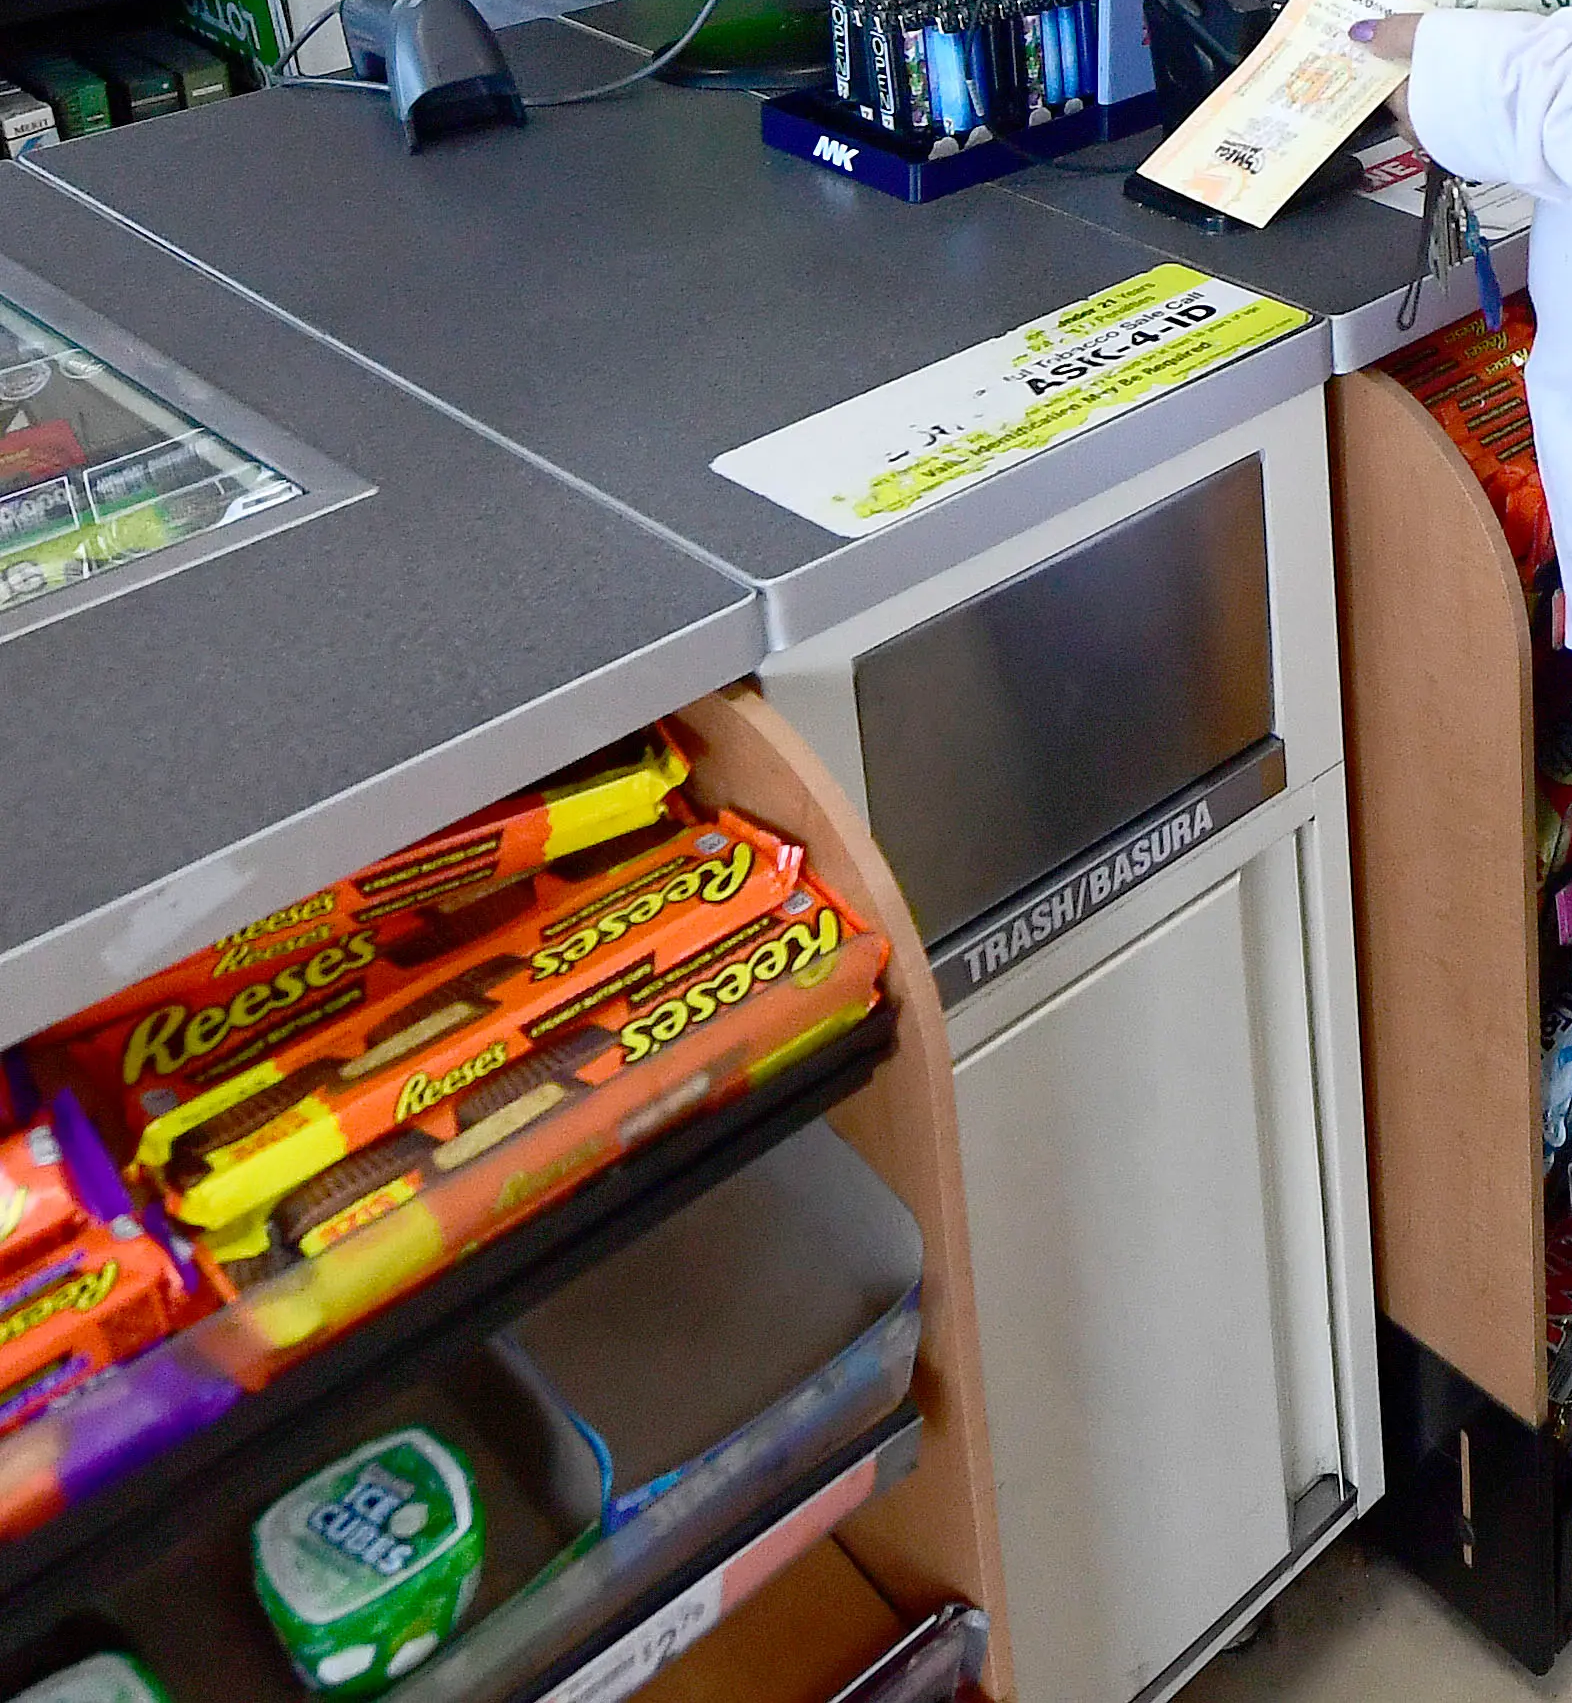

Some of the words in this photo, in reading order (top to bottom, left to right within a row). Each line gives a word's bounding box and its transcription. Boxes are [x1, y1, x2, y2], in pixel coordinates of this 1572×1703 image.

[1025, 303, 1218, 397] ASK-4-ID
[1032, 329, 1121, 371] Tobacco
[1119, 308, 1166, 333] Sale
[1164, 290, 1207, 310] Call
[1098, 297, 1118, 312] 21
[1117, 282, 1157, 301] Years
[1119, 373, 1144, 388] Be
[1142, 340, 1213, 378] Required
[530, 841, 755, 984] Reese's
[963, 799, 1214, 986] TRASH/BASURA
[122, 929, 378, 1087] Reese's
[620, 907, 841, 1063] Reese's
